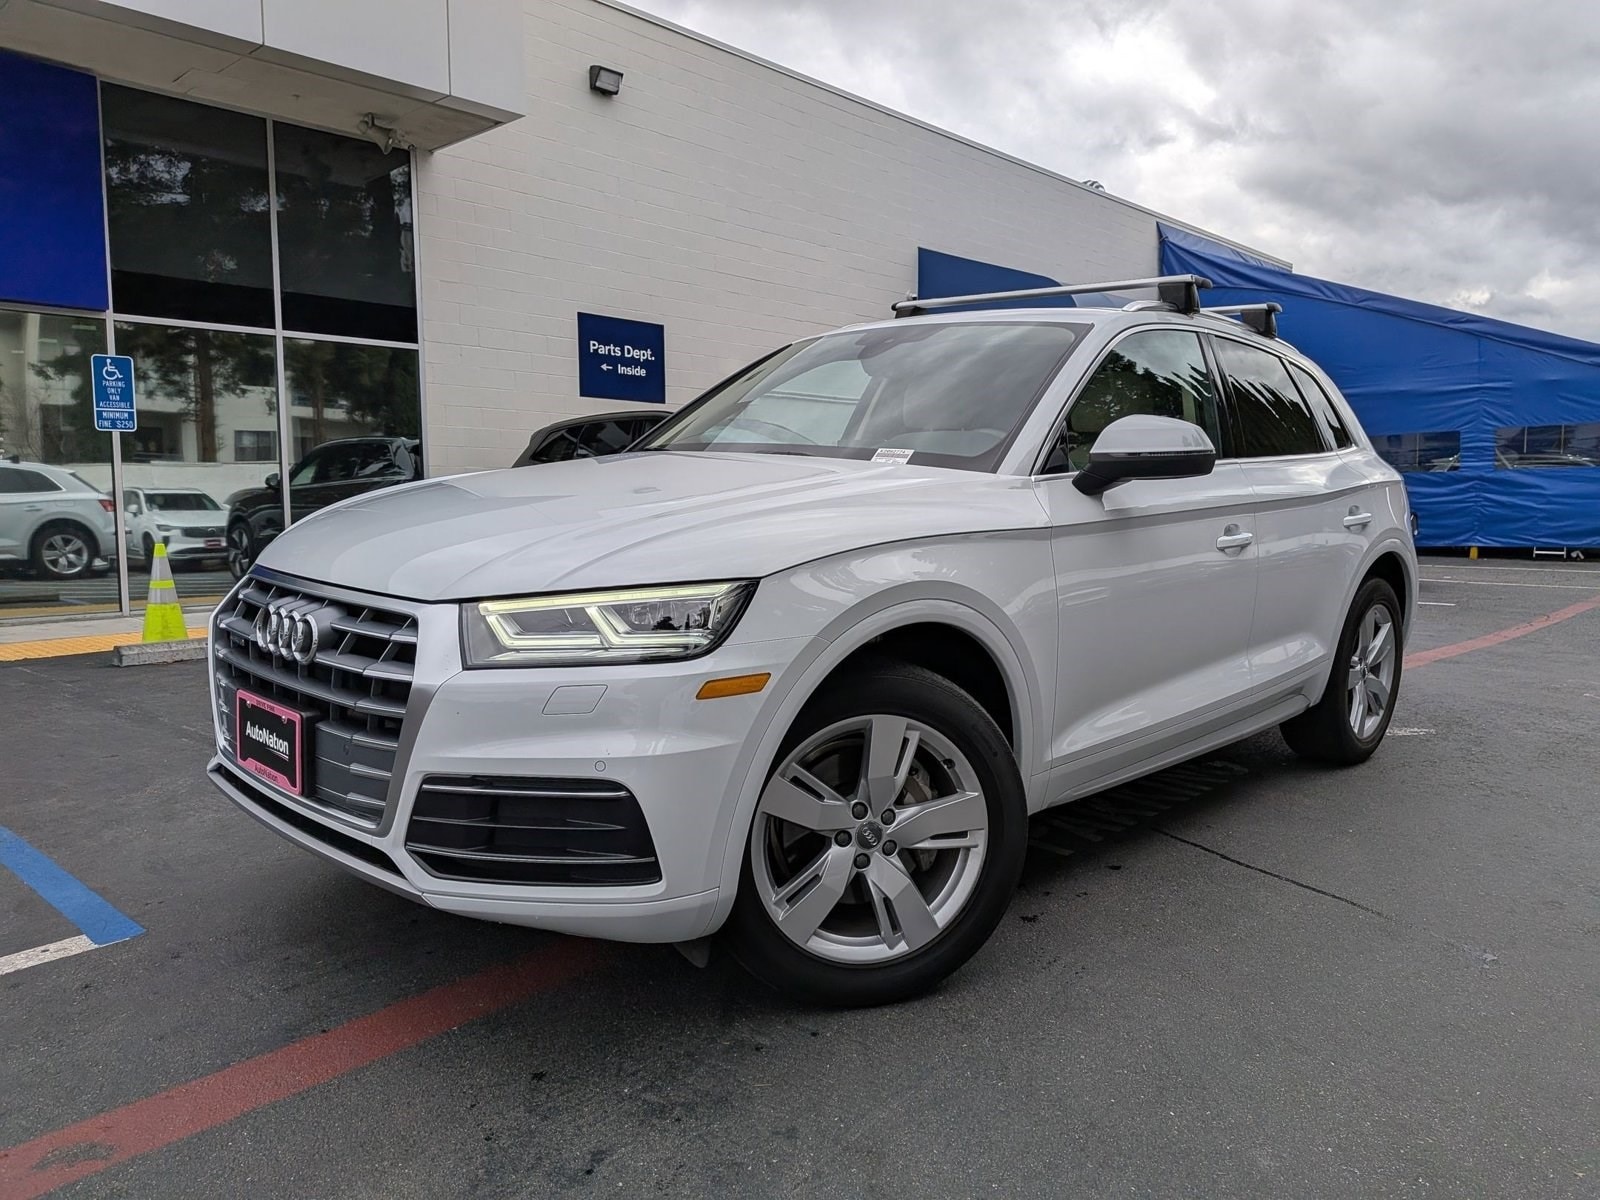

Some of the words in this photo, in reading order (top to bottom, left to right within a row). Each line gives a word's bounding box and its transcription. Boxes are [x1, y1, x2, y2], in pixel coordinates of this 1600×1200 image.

[589, 340, 621, 357] Parts
[624, 345, 655, 362] Dept.
[617, 363, 647, 377] Inside
[102, 411, 128, 419] MINIMUM
[246, 721, 289, 755] AutoNation
